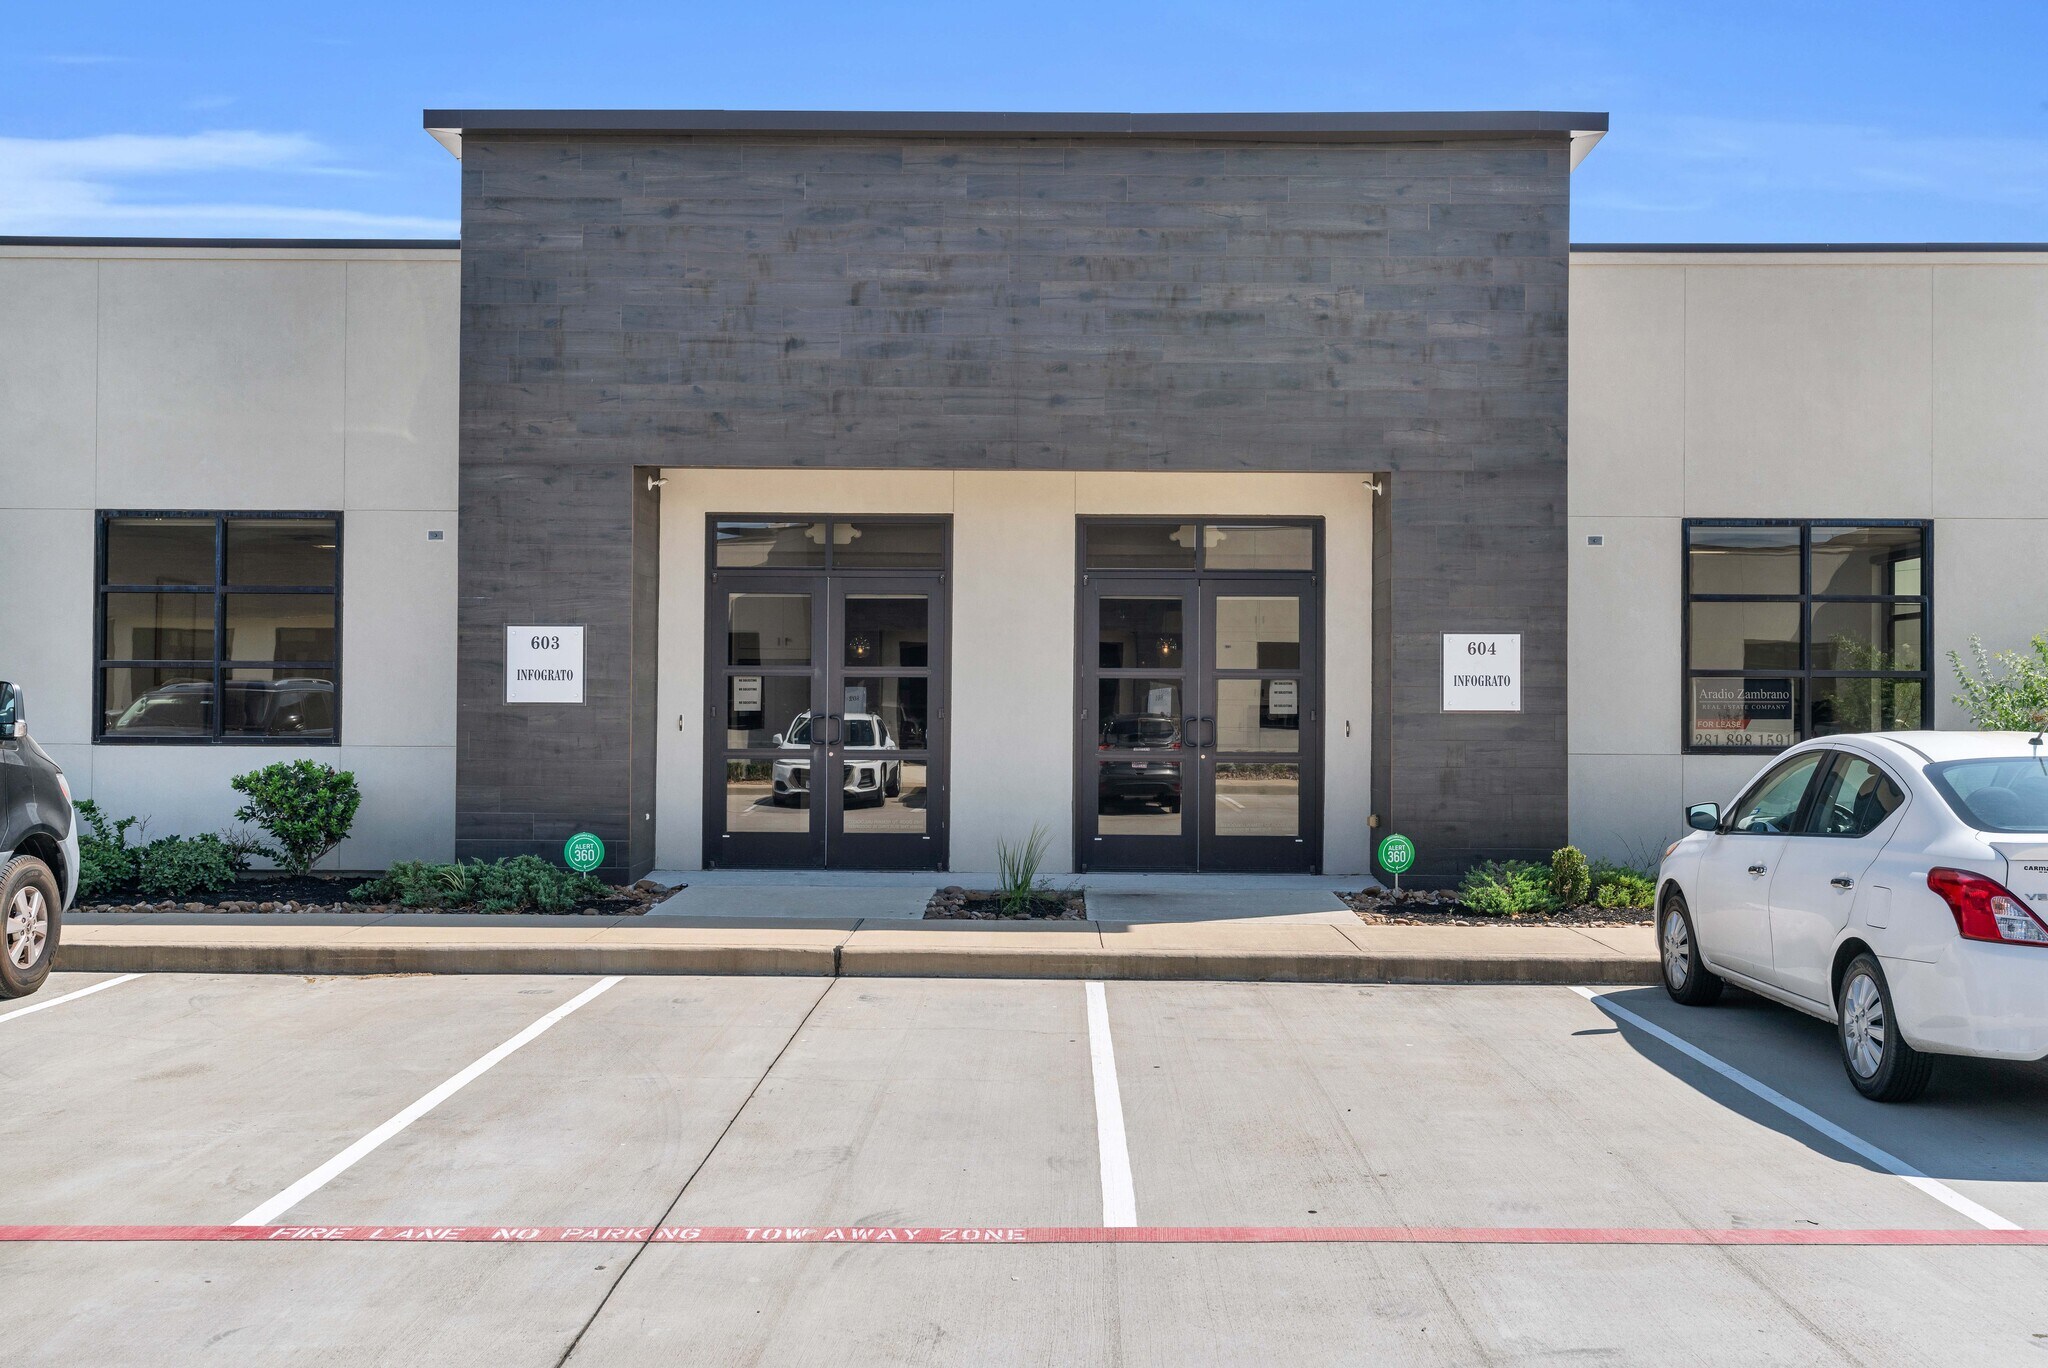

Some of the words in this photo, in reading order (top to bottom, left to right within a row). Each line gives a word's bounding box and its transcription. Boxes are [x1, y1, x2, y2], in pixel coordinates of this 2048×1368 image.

[531, 635, 560, 650] 603
[1467, 641, 1497, 656] 604
[517, 669, 574, 681] INFOGRATO
[1453, 674, 1511, 687] INFOGRATO
[1699, 688, 1734, 700] Aradio
[1737, 688, 1790, 700] Zambrano
[1697, 720, 1714, 728] FOR
[1715, 720, 1742, 728] LEASE
[1695, 733, 1791, 746] 281.898.1591
[574, 849, 595, 862] 360
[1387, 850, 1406, 863] 360
[268, 1227, 353, 1239] FIRE
[369, 1228, 466, 1239] LANE
[492, 1228, 540, 1239] NO
[560, 1228, 702, 1239] PARKNG
[744, 1228, 811, 1240] TOW
[823, 1228, 921, 1240] AWAY
[939, 1229, 1026, 1241] ZONE
